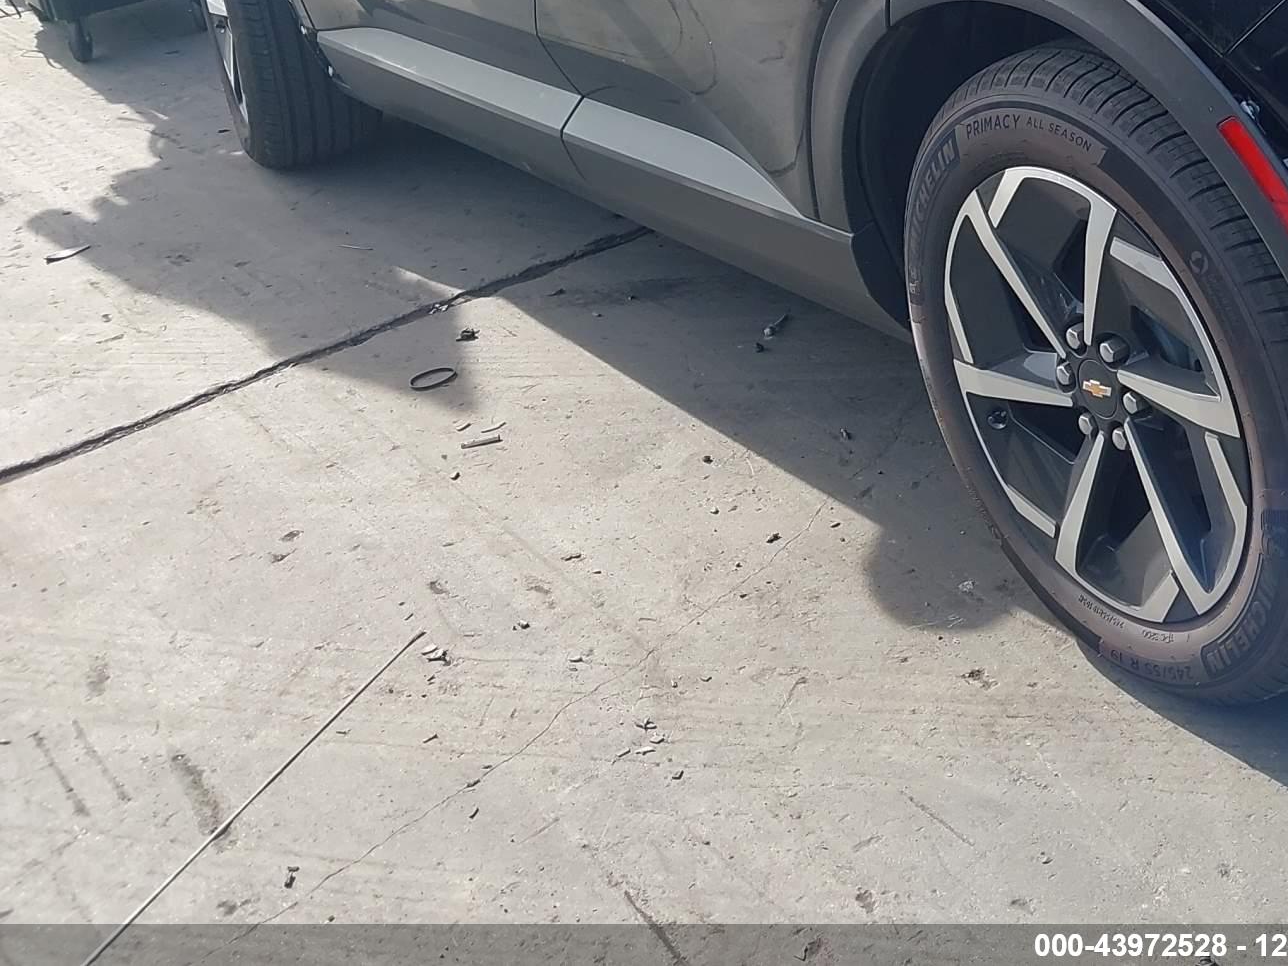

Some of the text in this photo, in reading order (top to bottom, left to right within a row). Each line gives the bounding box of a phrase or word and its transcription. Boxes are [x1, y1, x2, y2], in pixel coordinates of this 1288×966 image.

[965, 113, 1093, 152] PRIMACY ALL SEASON
